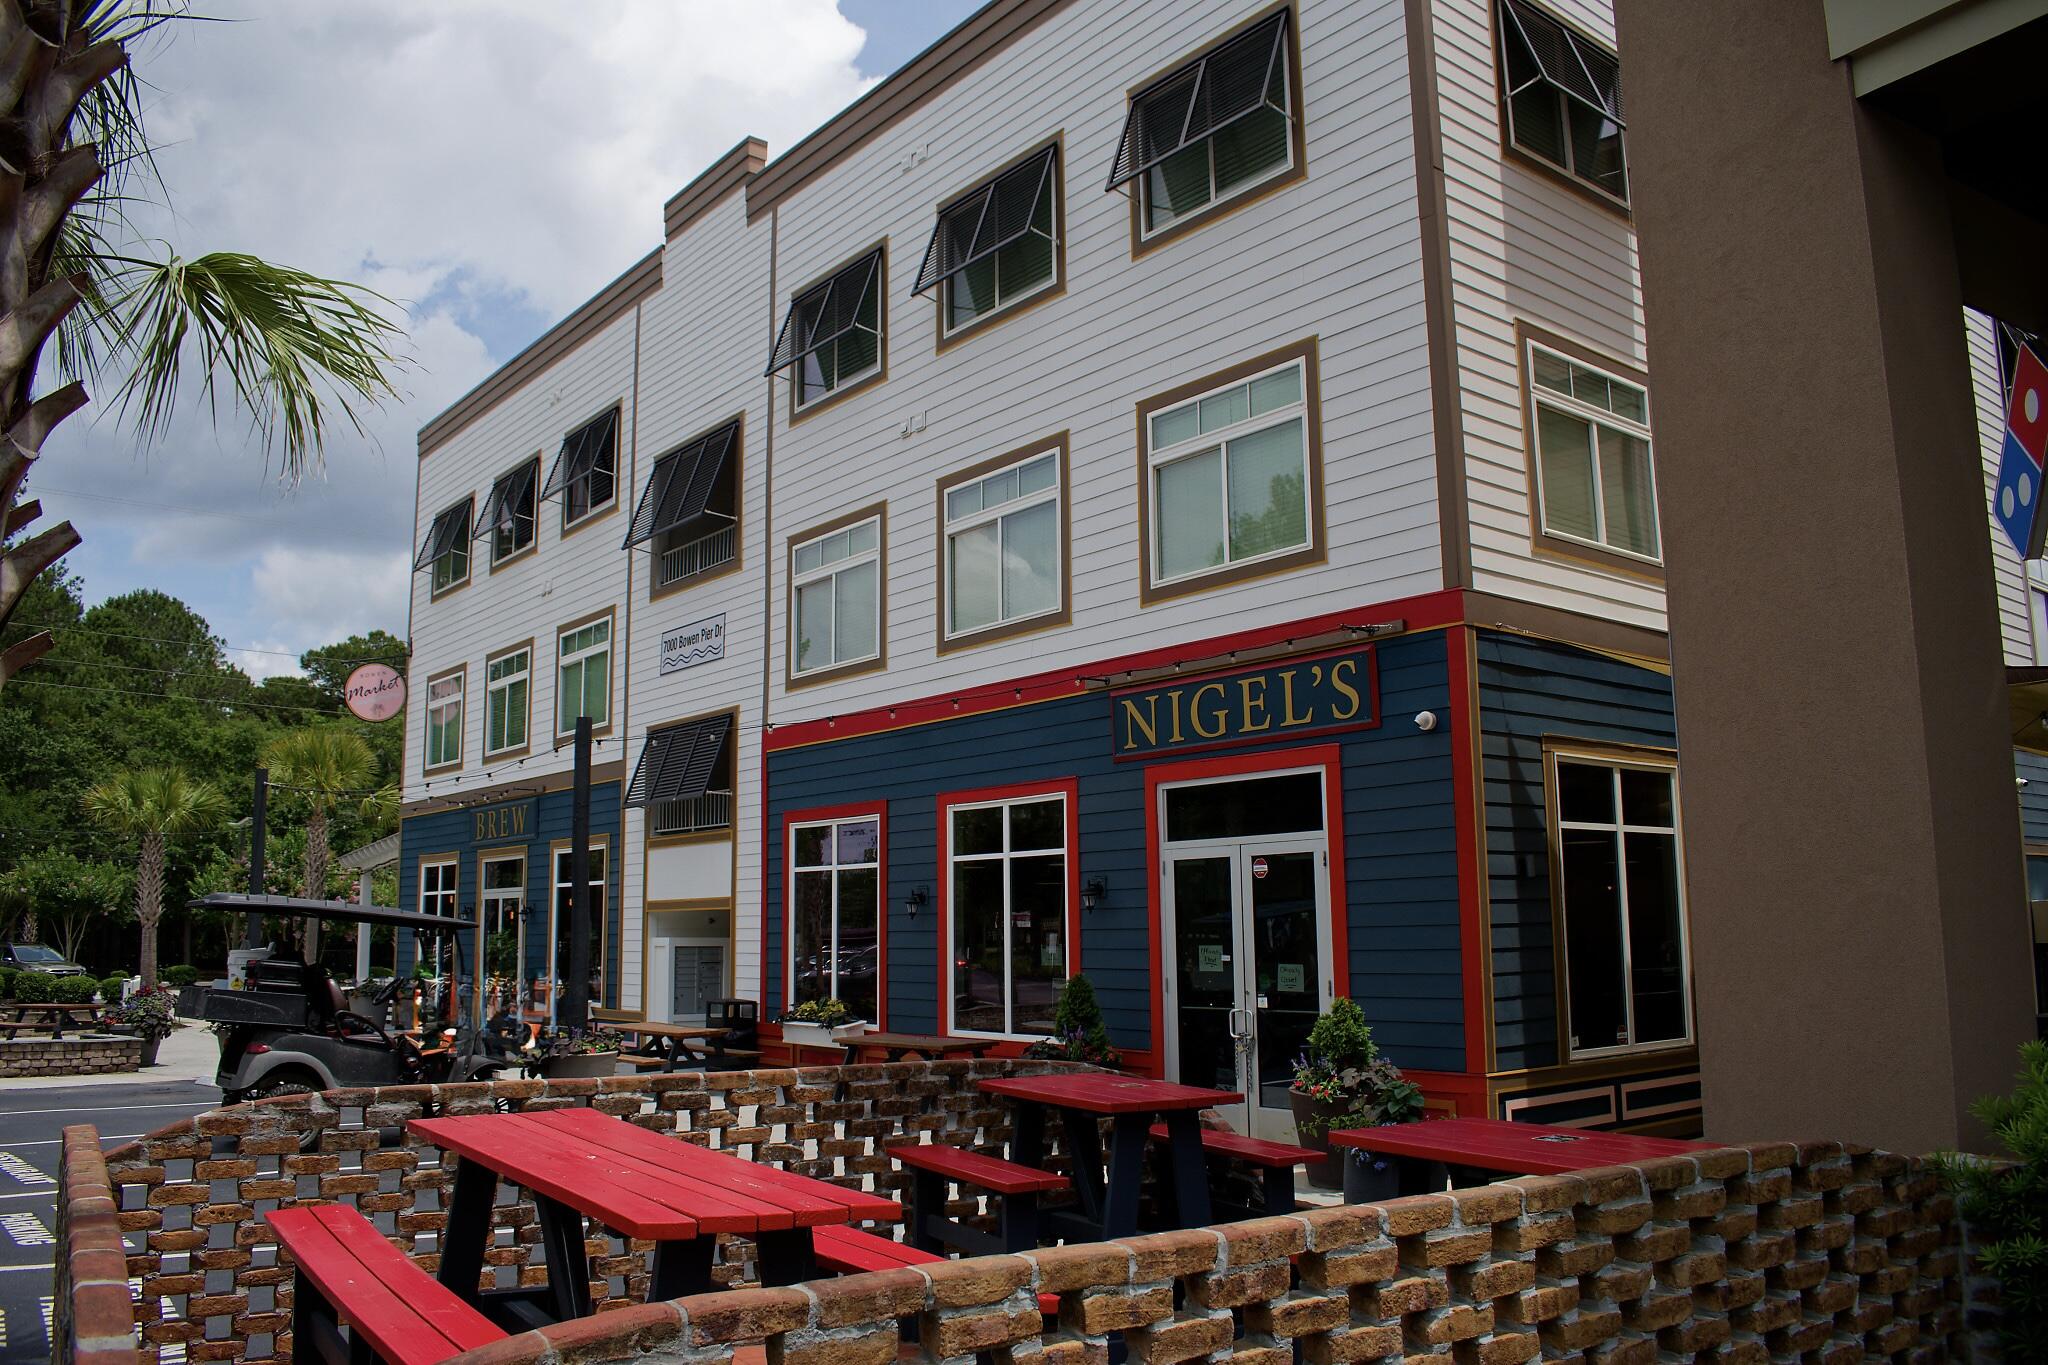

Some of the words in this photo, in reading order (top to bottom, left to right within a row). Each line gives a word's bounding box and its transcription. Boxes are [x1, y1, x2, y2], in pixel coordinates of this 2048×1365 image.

[664, 637, 678, 653] 7000
[679, 633, 699, 649] Bowen
[701, 628, 714, 642] Pier
[715, 624, 723, 637] Dr
[348, 675, 401, 701] Market
[1121, 659, 1360, 750] NIGEL'S
[476, 804, 529, 841] BREW
[0, 1212, 57, 1246] PARKING
